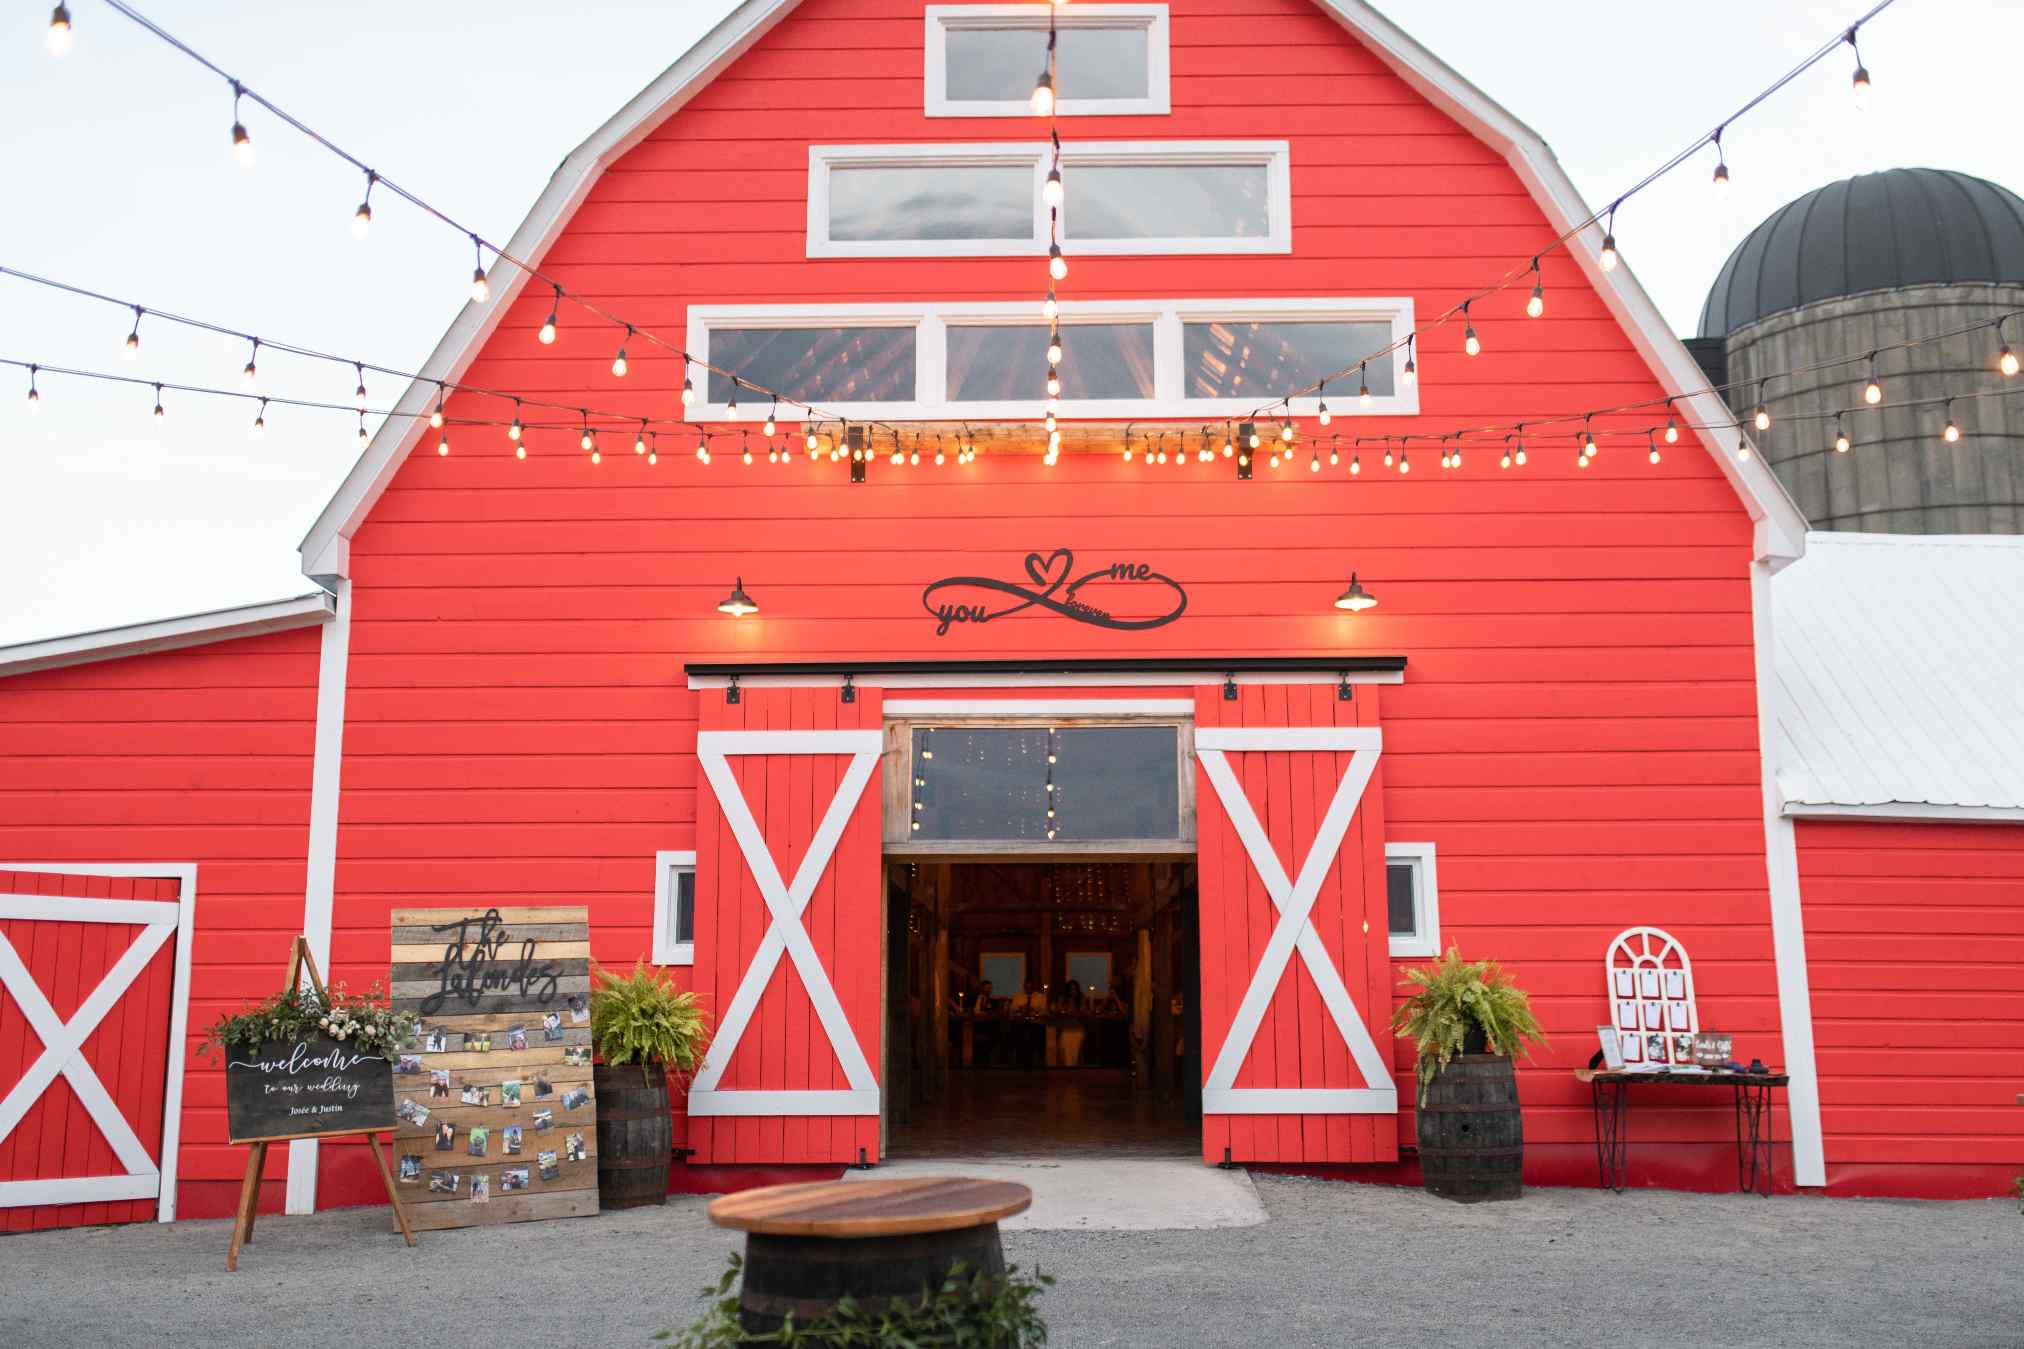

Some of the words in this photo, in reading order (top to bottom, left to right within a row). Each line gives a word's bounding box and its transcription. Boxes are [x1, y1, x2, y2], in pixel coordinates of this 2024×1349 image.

[937, 603, 989, 636] you
[1110, 562, 1150, 581] me
[432, 908, 510, 971] The
[229, 1042, 385, 1074] welcome
[264, 1083, 279, 1095] to
[282, 1083, 303, 1095] our
[307, 1076, 360, 1099] wedding
[311, 1105, 318, 1114] &
[319, 1104, 343, 1114] Justin
